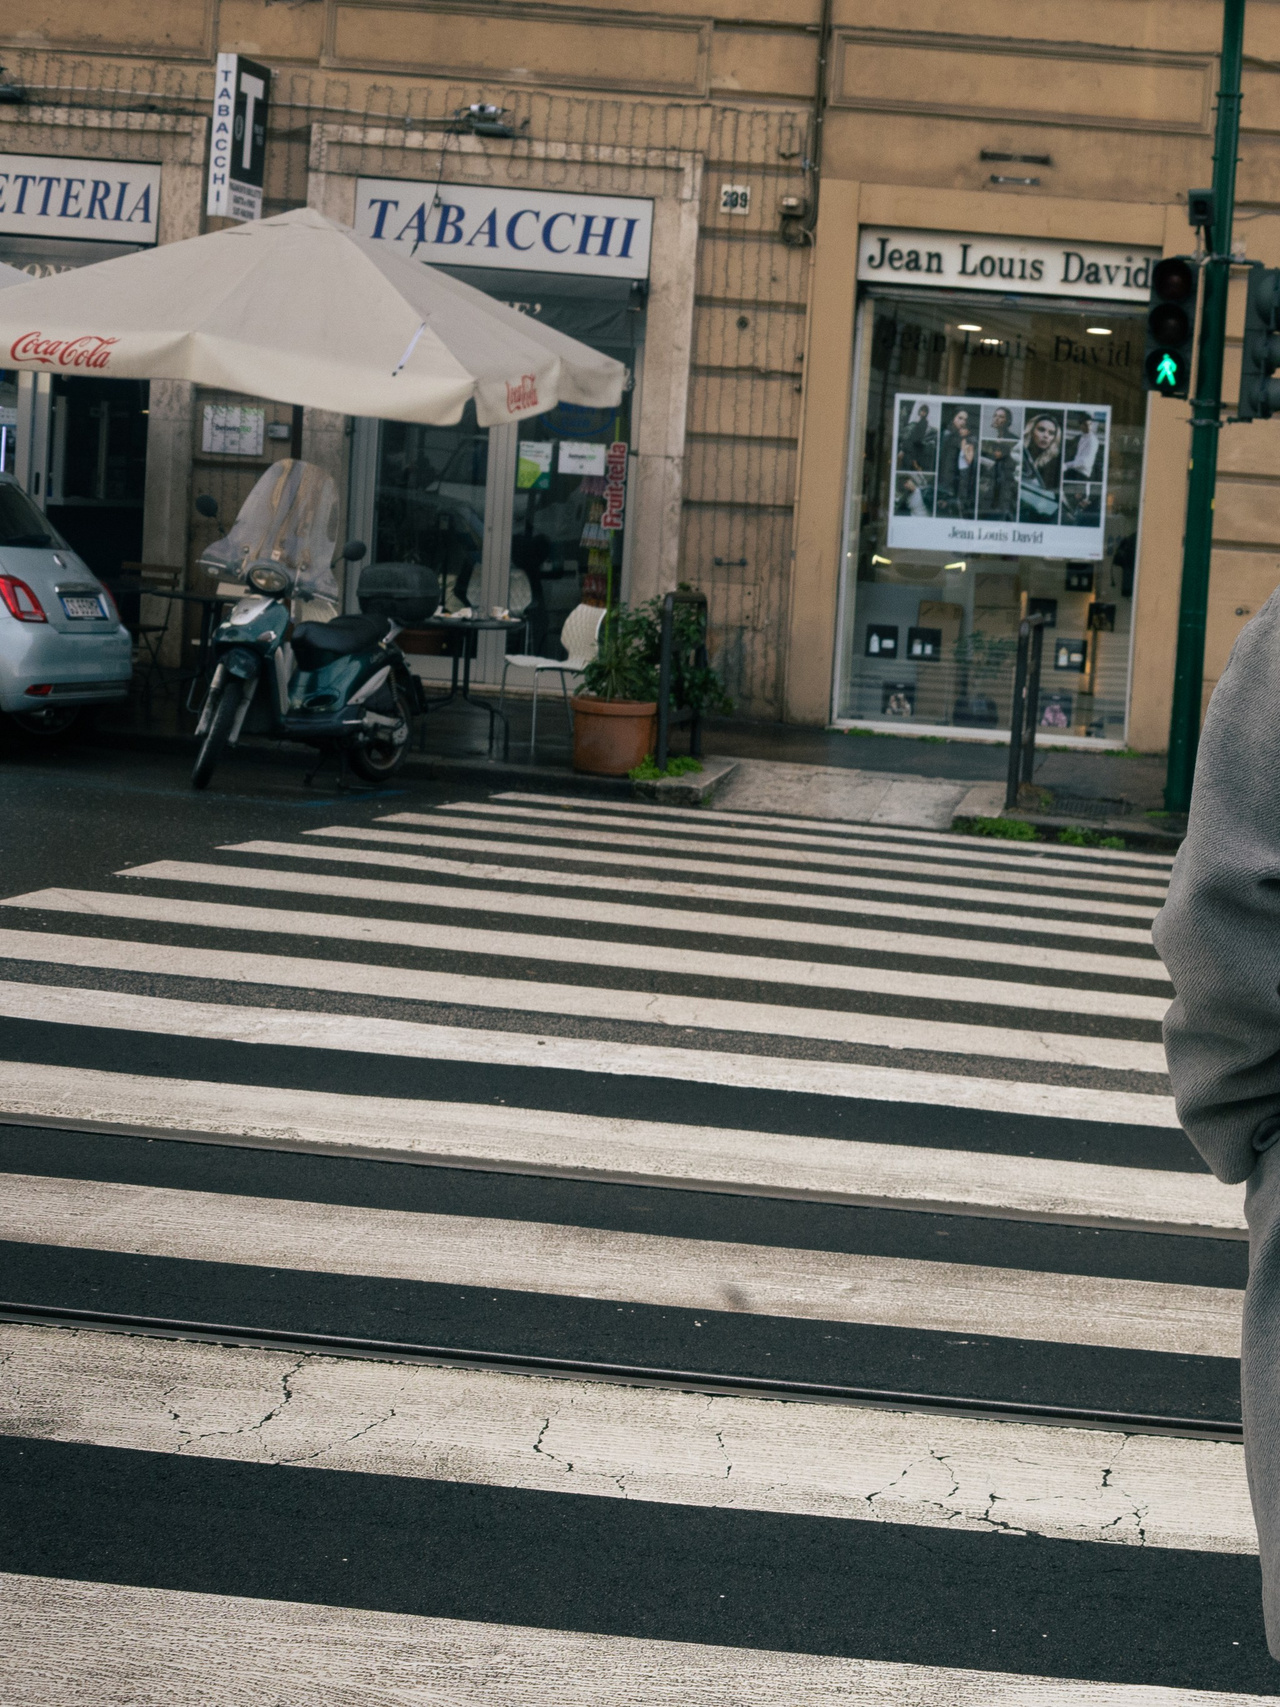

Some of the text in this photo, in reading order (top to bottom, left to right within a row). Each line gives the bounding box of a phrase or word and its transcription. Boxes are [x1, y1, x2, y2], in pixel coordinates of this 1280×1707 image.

[213, 70, 232, 202] TABACCHI
[240, 71, 265, 170] T
[368, 199, 640, 259] TABACCHI
[868, 237, 1151, 289] Jean Louis David
[10, 331, 121, 369] Coca-Cola
[603, 443, 627, 528] Fruit-tella
[948, 526, 1044, 544] Jean Louis David
